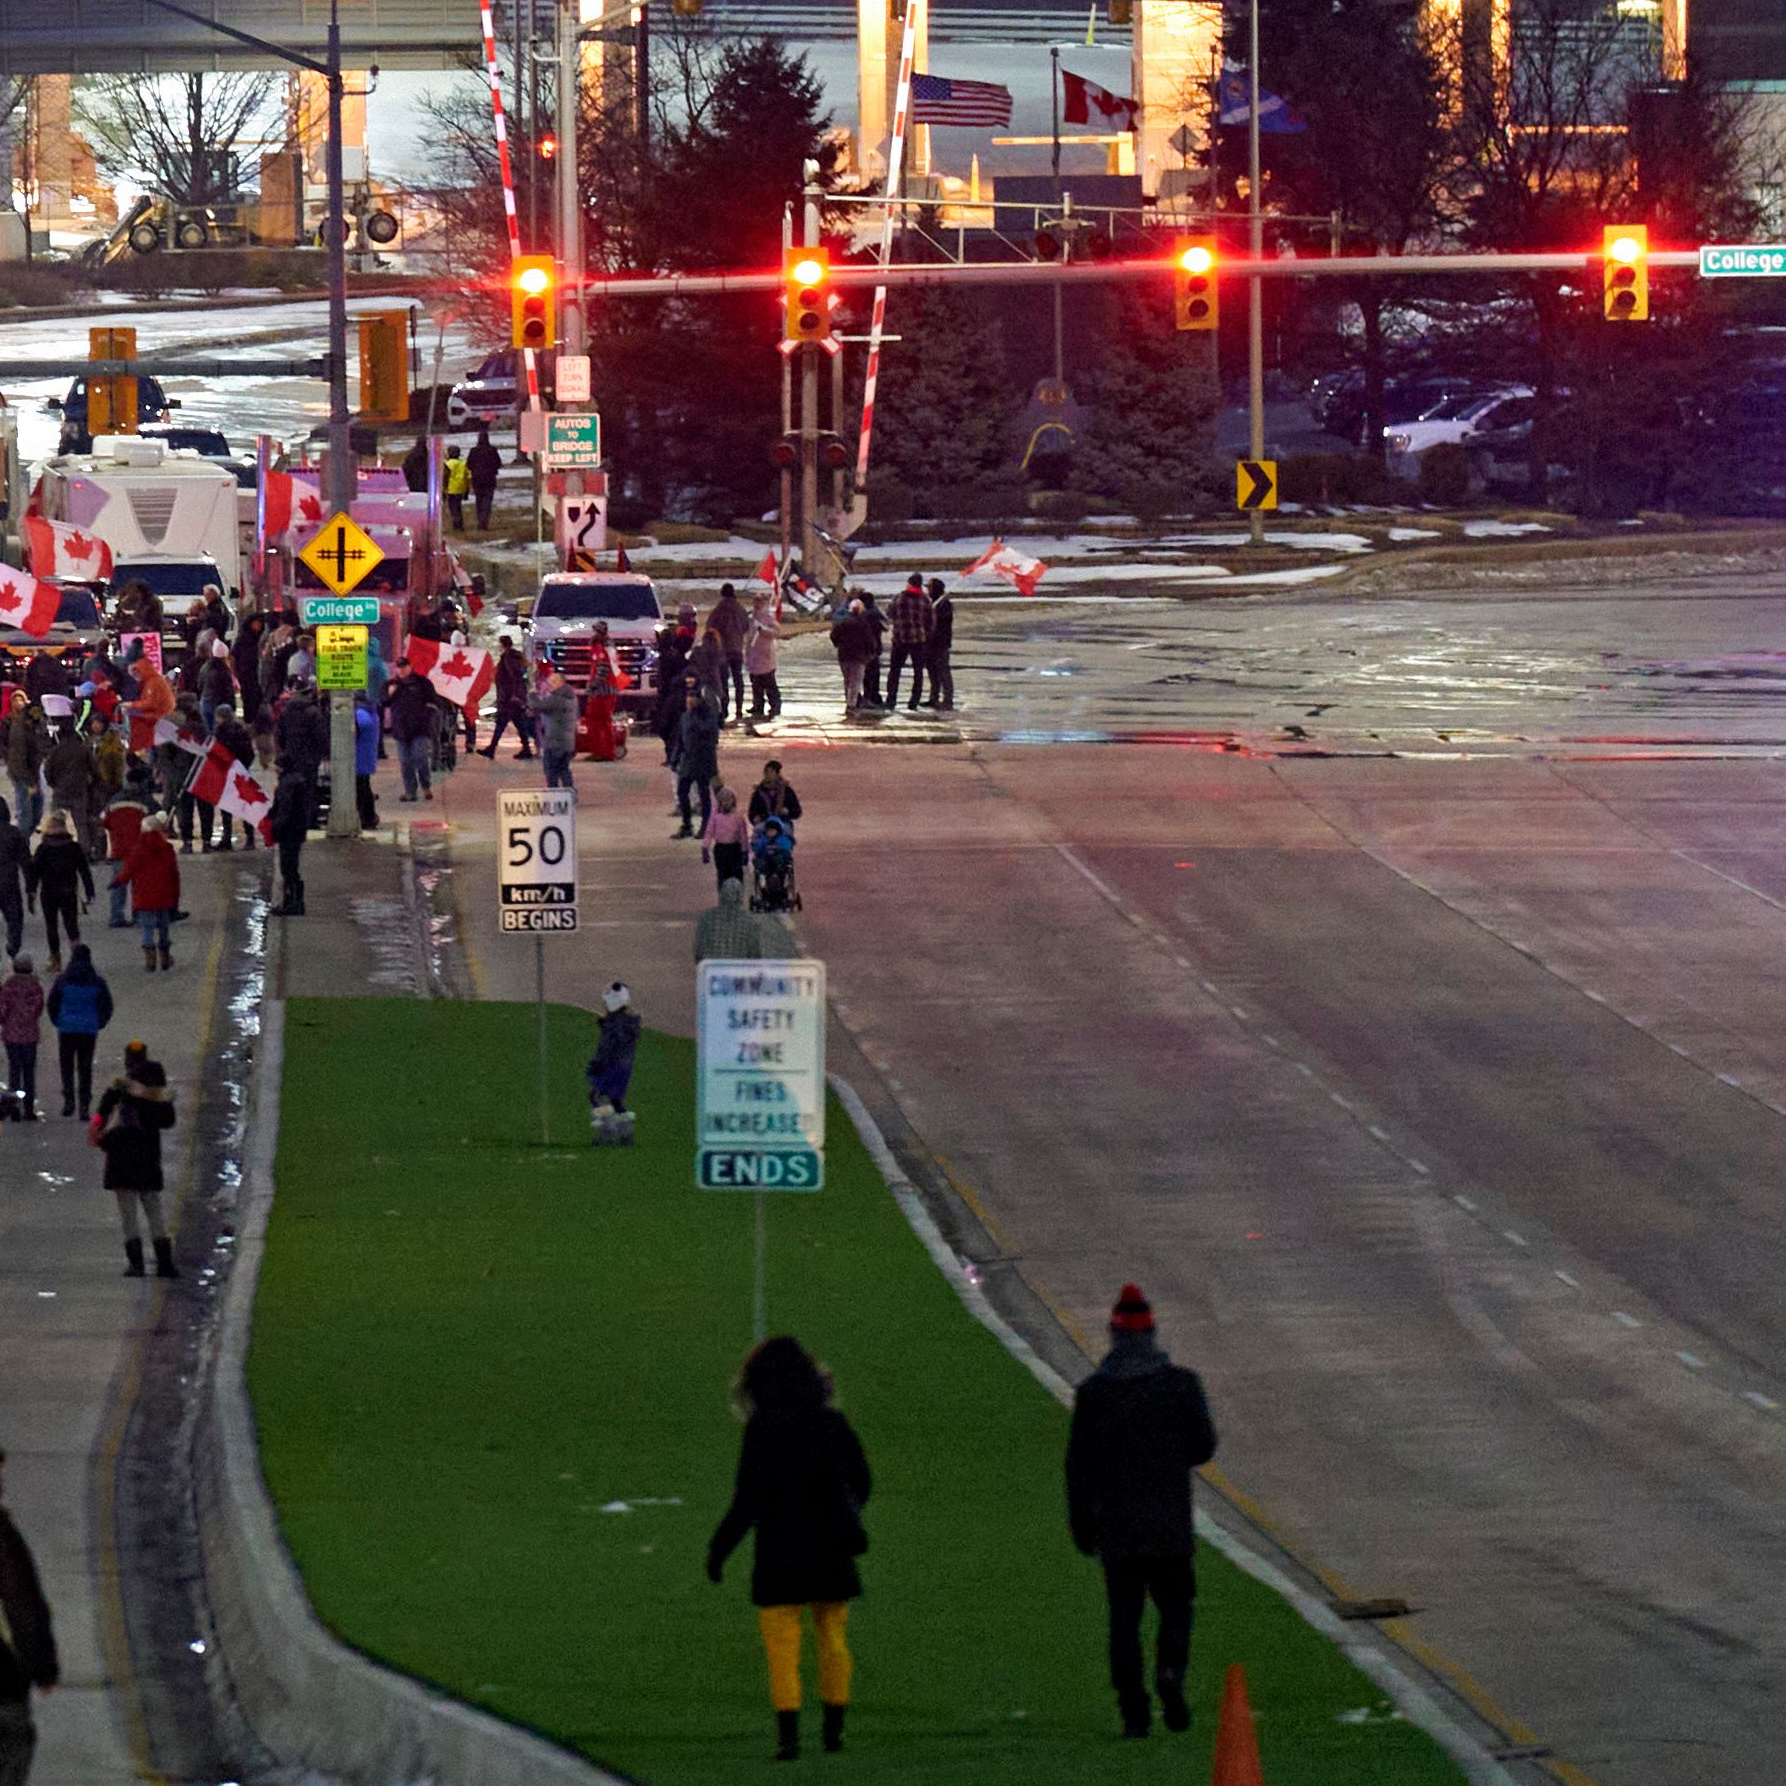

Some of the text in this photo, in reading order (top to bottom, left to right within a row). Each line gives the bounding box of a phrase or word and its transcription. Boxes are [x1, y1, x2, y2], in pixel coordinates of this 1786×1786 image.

[1707, 251, 1784, 273] College
[563, 363, 581, 372] LEFT
[563, 374, 583, 382] TURN
[554, 419, 592, 429] AUTOS
[568, 431, 579, 439] TO
[552, 441, 593, 451] BRIDGE
[549, 454, 598, 463] KEEP LEFT
[307, 602, 364, 621] College
[504, 801, 569, 817] MAXIMUM
[508, 825, 566, 867] 50
[510, 886, 566, 903] km/h
[504, 911, 575, 930] BEGINS
[728, 1009, 795, 1029] SAFETY
[736, 1042, 783, 1063] ZONE
[735, 1081, 786, 1101] FINES
[711, 1155, 809, 1184] ENDS
